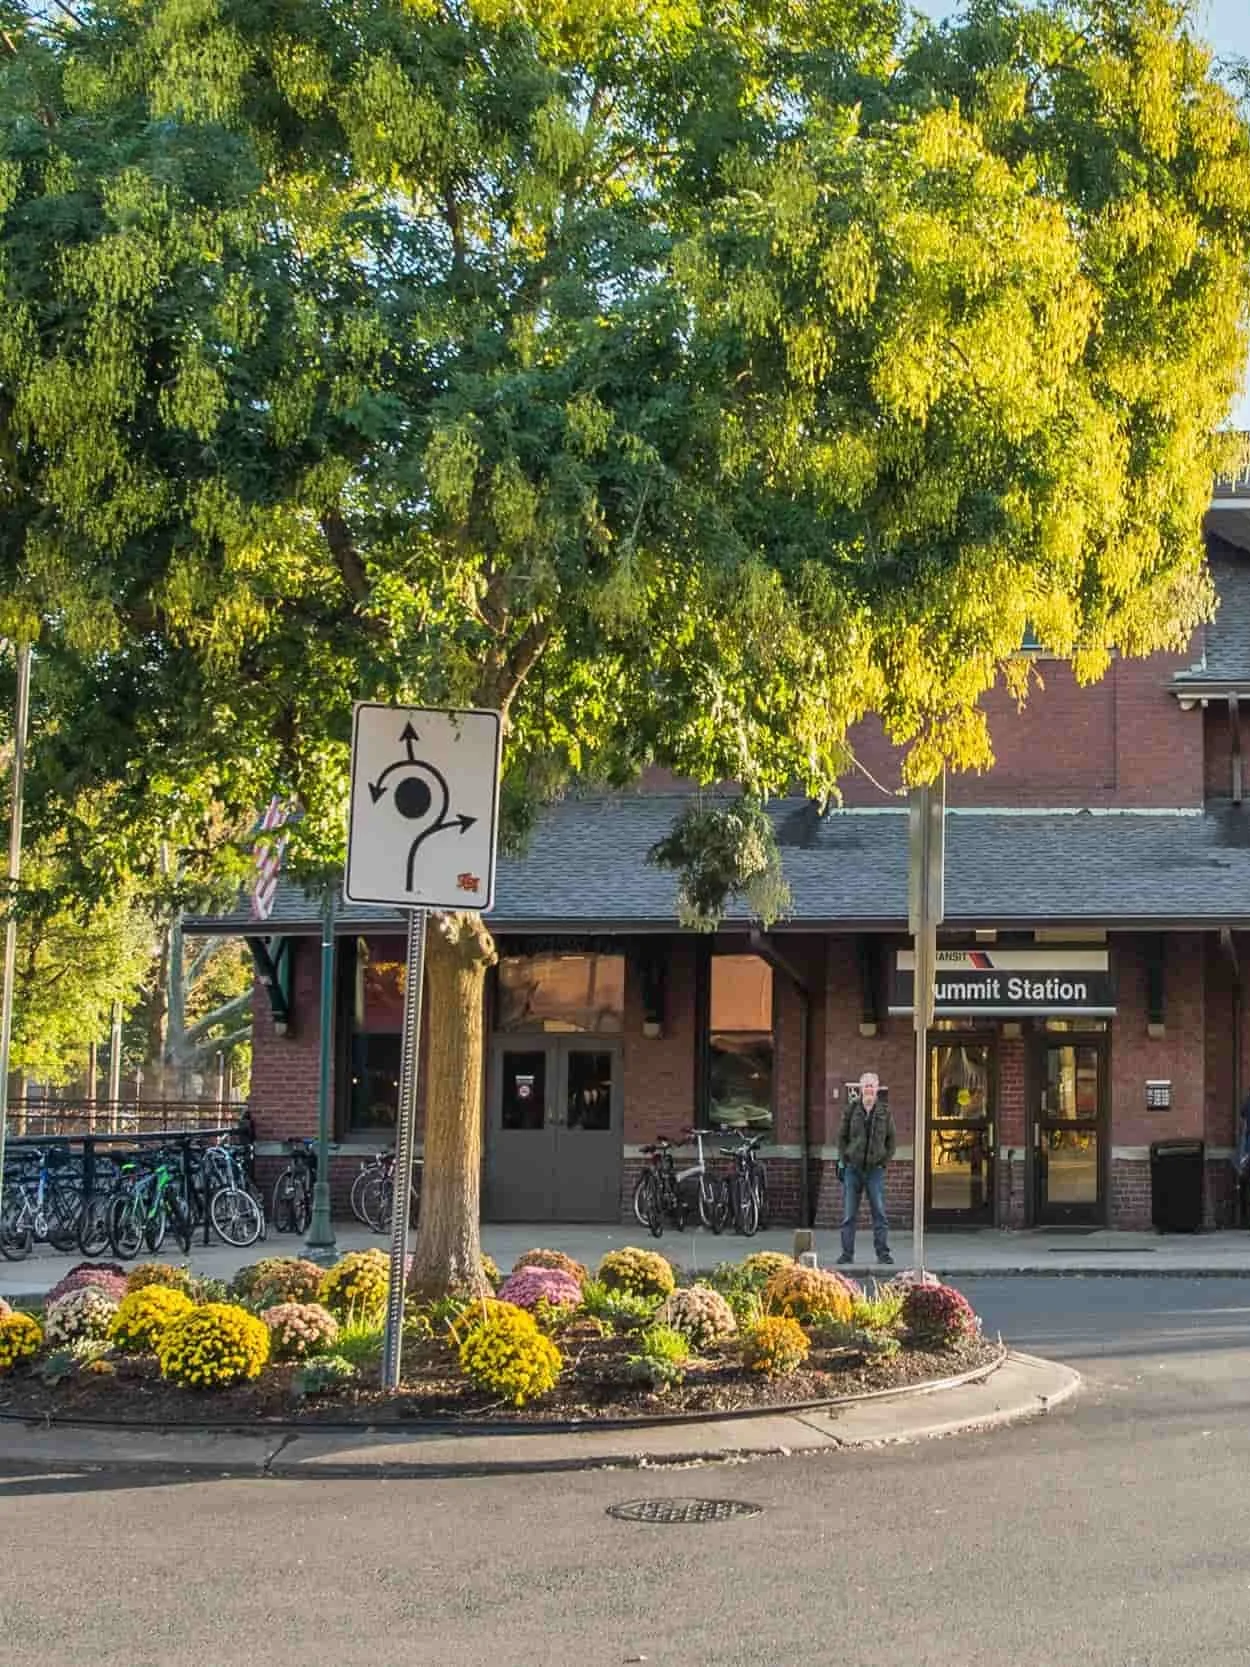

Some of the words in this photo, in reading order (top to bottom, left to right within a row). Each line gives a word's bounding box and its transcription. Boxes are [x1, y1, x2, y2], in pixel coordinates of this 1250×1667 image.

[936, 951, 967, 961] ANSIT
[934, 977, 1001, 1000] ummit
[1007, 977, 1087, 1000] Station
